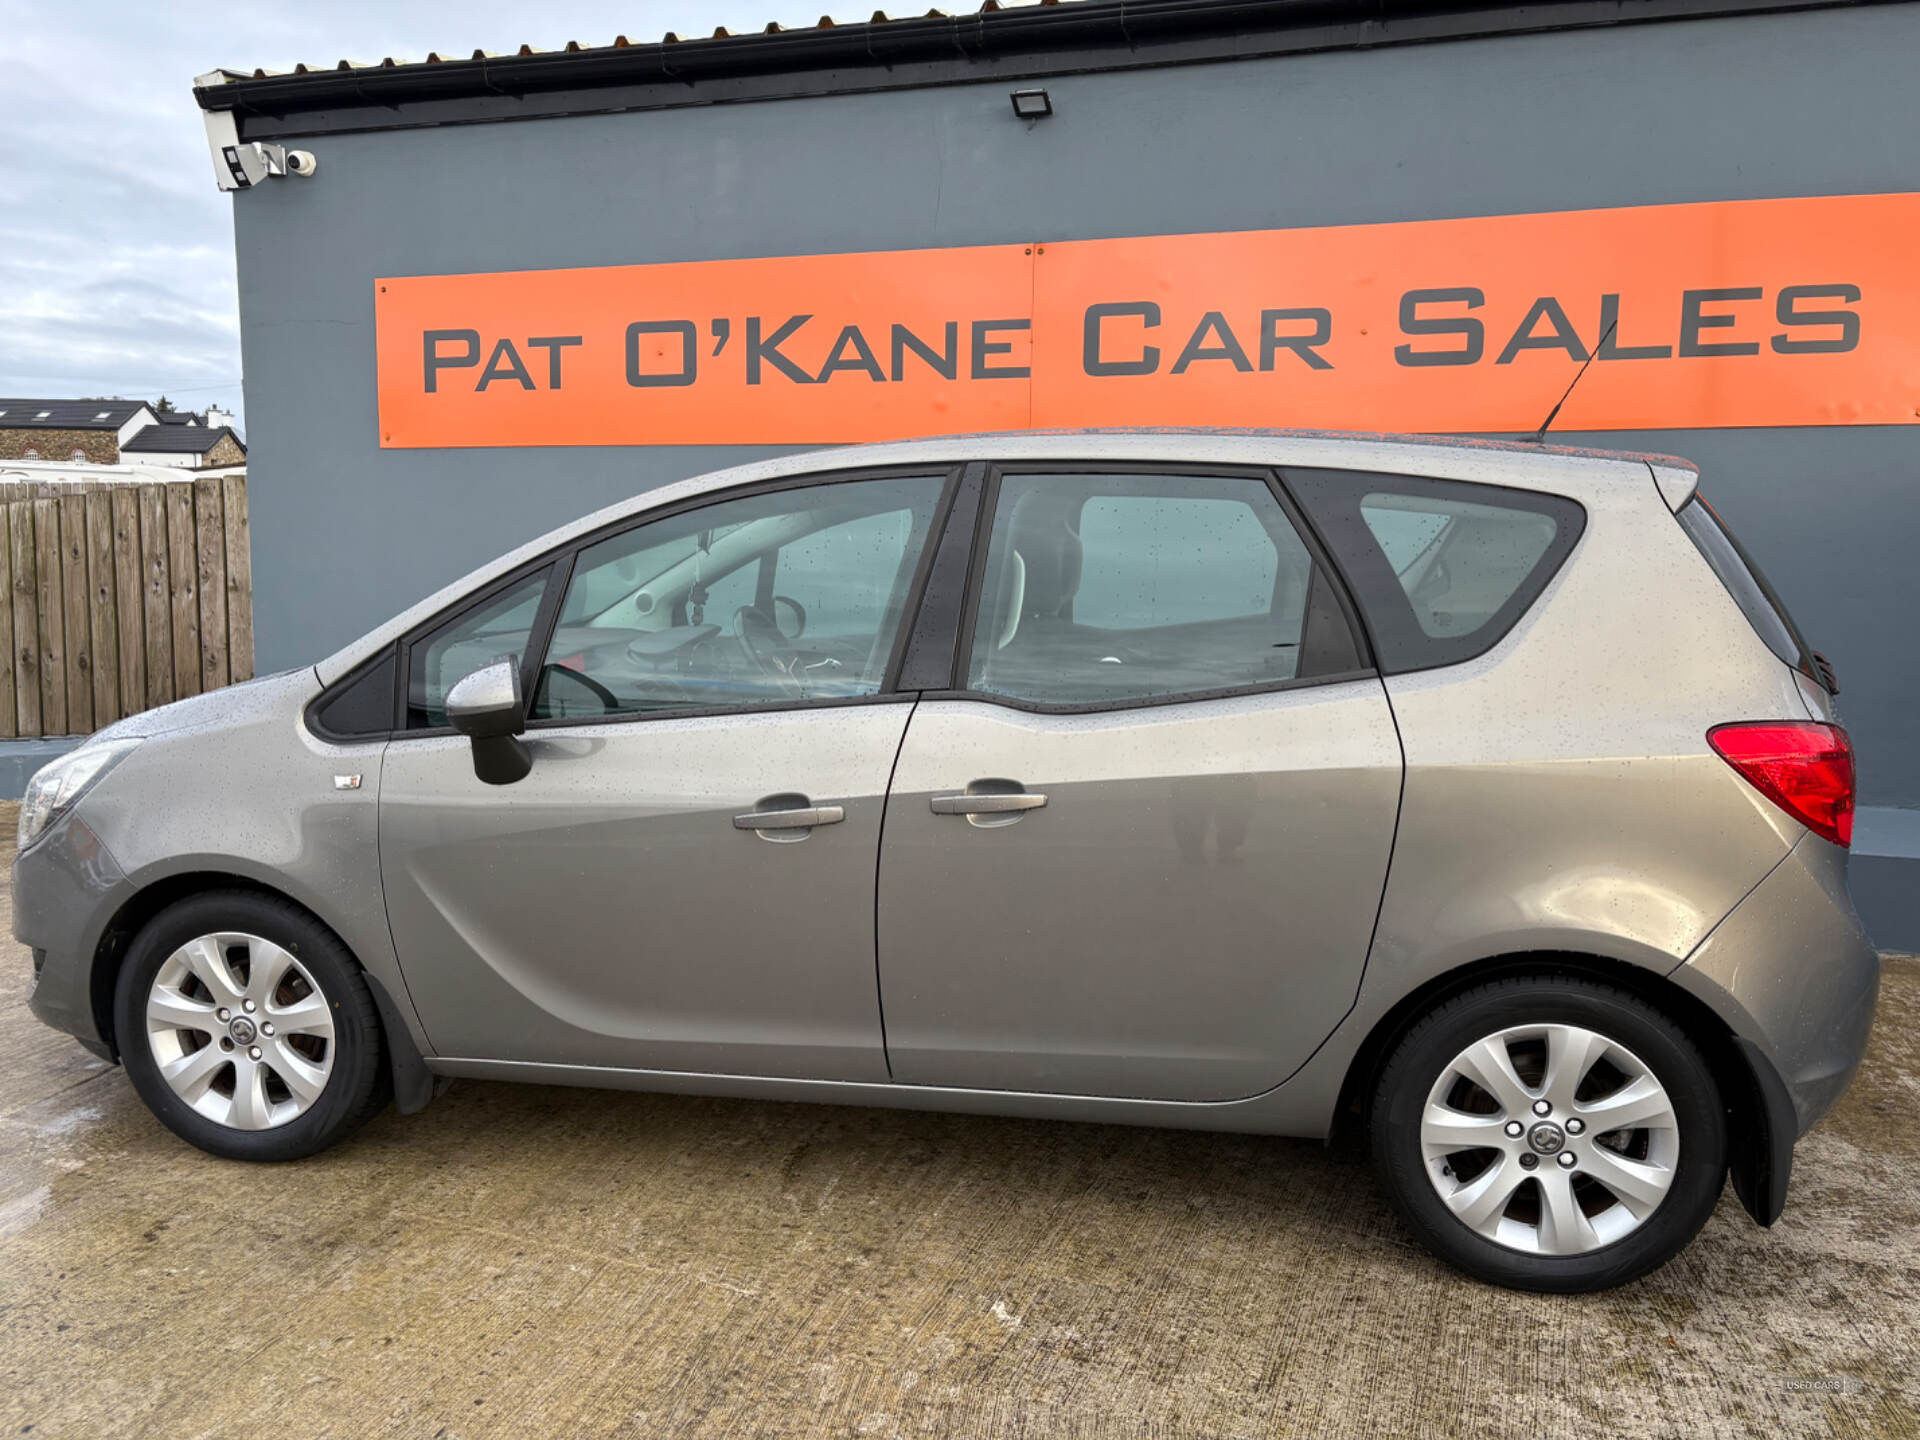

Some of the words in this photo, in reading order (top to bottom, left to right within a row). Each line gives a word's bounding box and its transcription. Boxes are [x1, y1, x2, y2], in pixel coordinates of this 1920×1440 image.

[424, 329, 583, 393] PAT
[626, 314, 1032, 387] O'KANE
[1083, 301, 1335, 376] CAR
[1394, 284, 1862, 367] SALES
